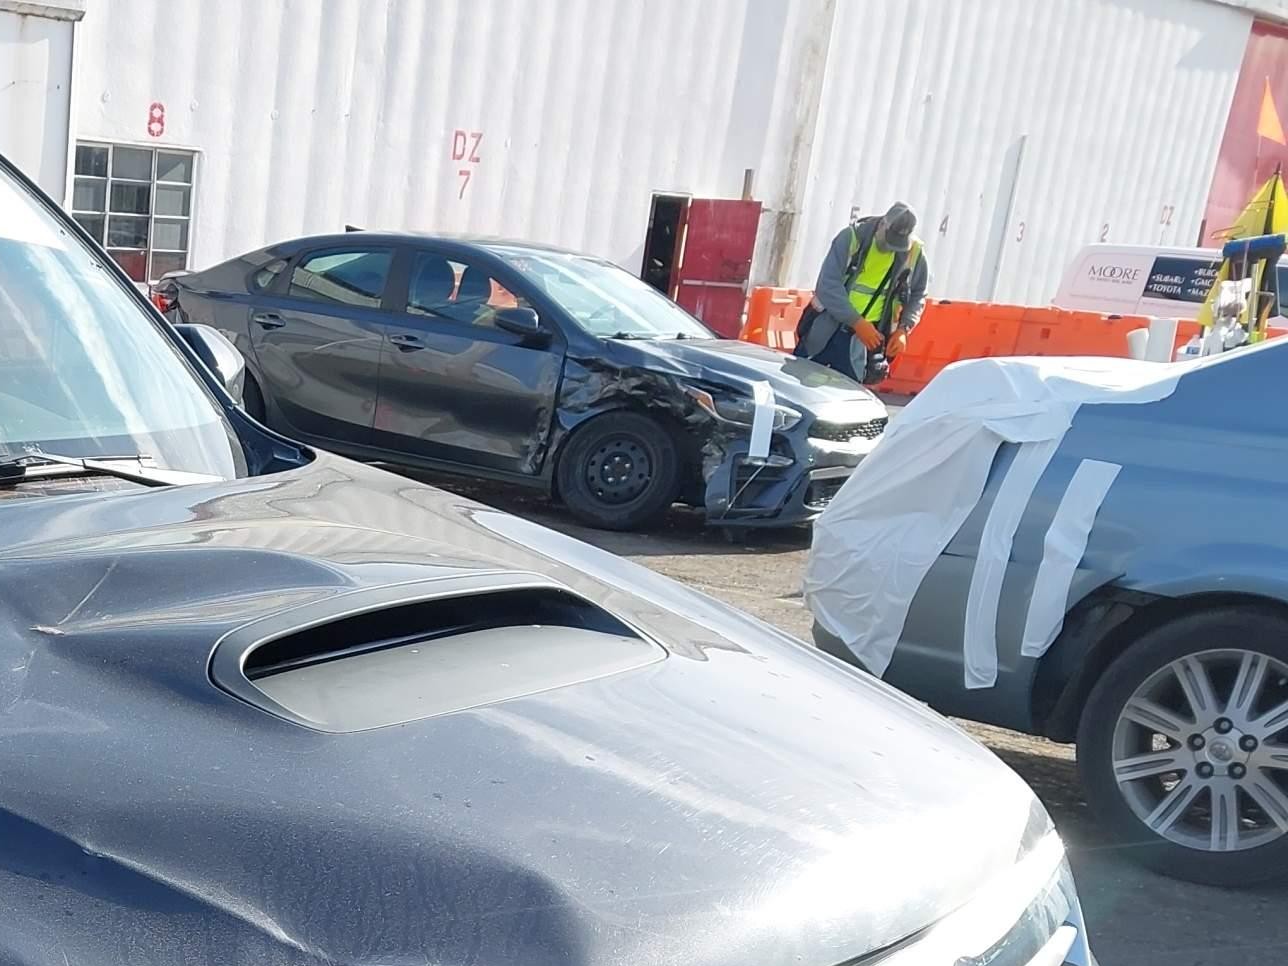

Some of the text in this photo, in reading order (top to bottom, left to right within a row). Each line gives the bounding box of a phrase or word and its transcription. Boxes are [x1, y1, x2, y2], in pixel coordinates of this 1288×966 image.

[147, 102, 165, 137] 8
[452, 129, 483, 163] DZ
[459, 169, 471, 200] 7
[939, 215, 950, 237] 4
[1016, 222, 1025, 243] 3
[1100, 223, 1110, 242] 2
[1088, 265, 1142, 280] MOORE
[1153, 283, 1181, 295] TOYOTA
